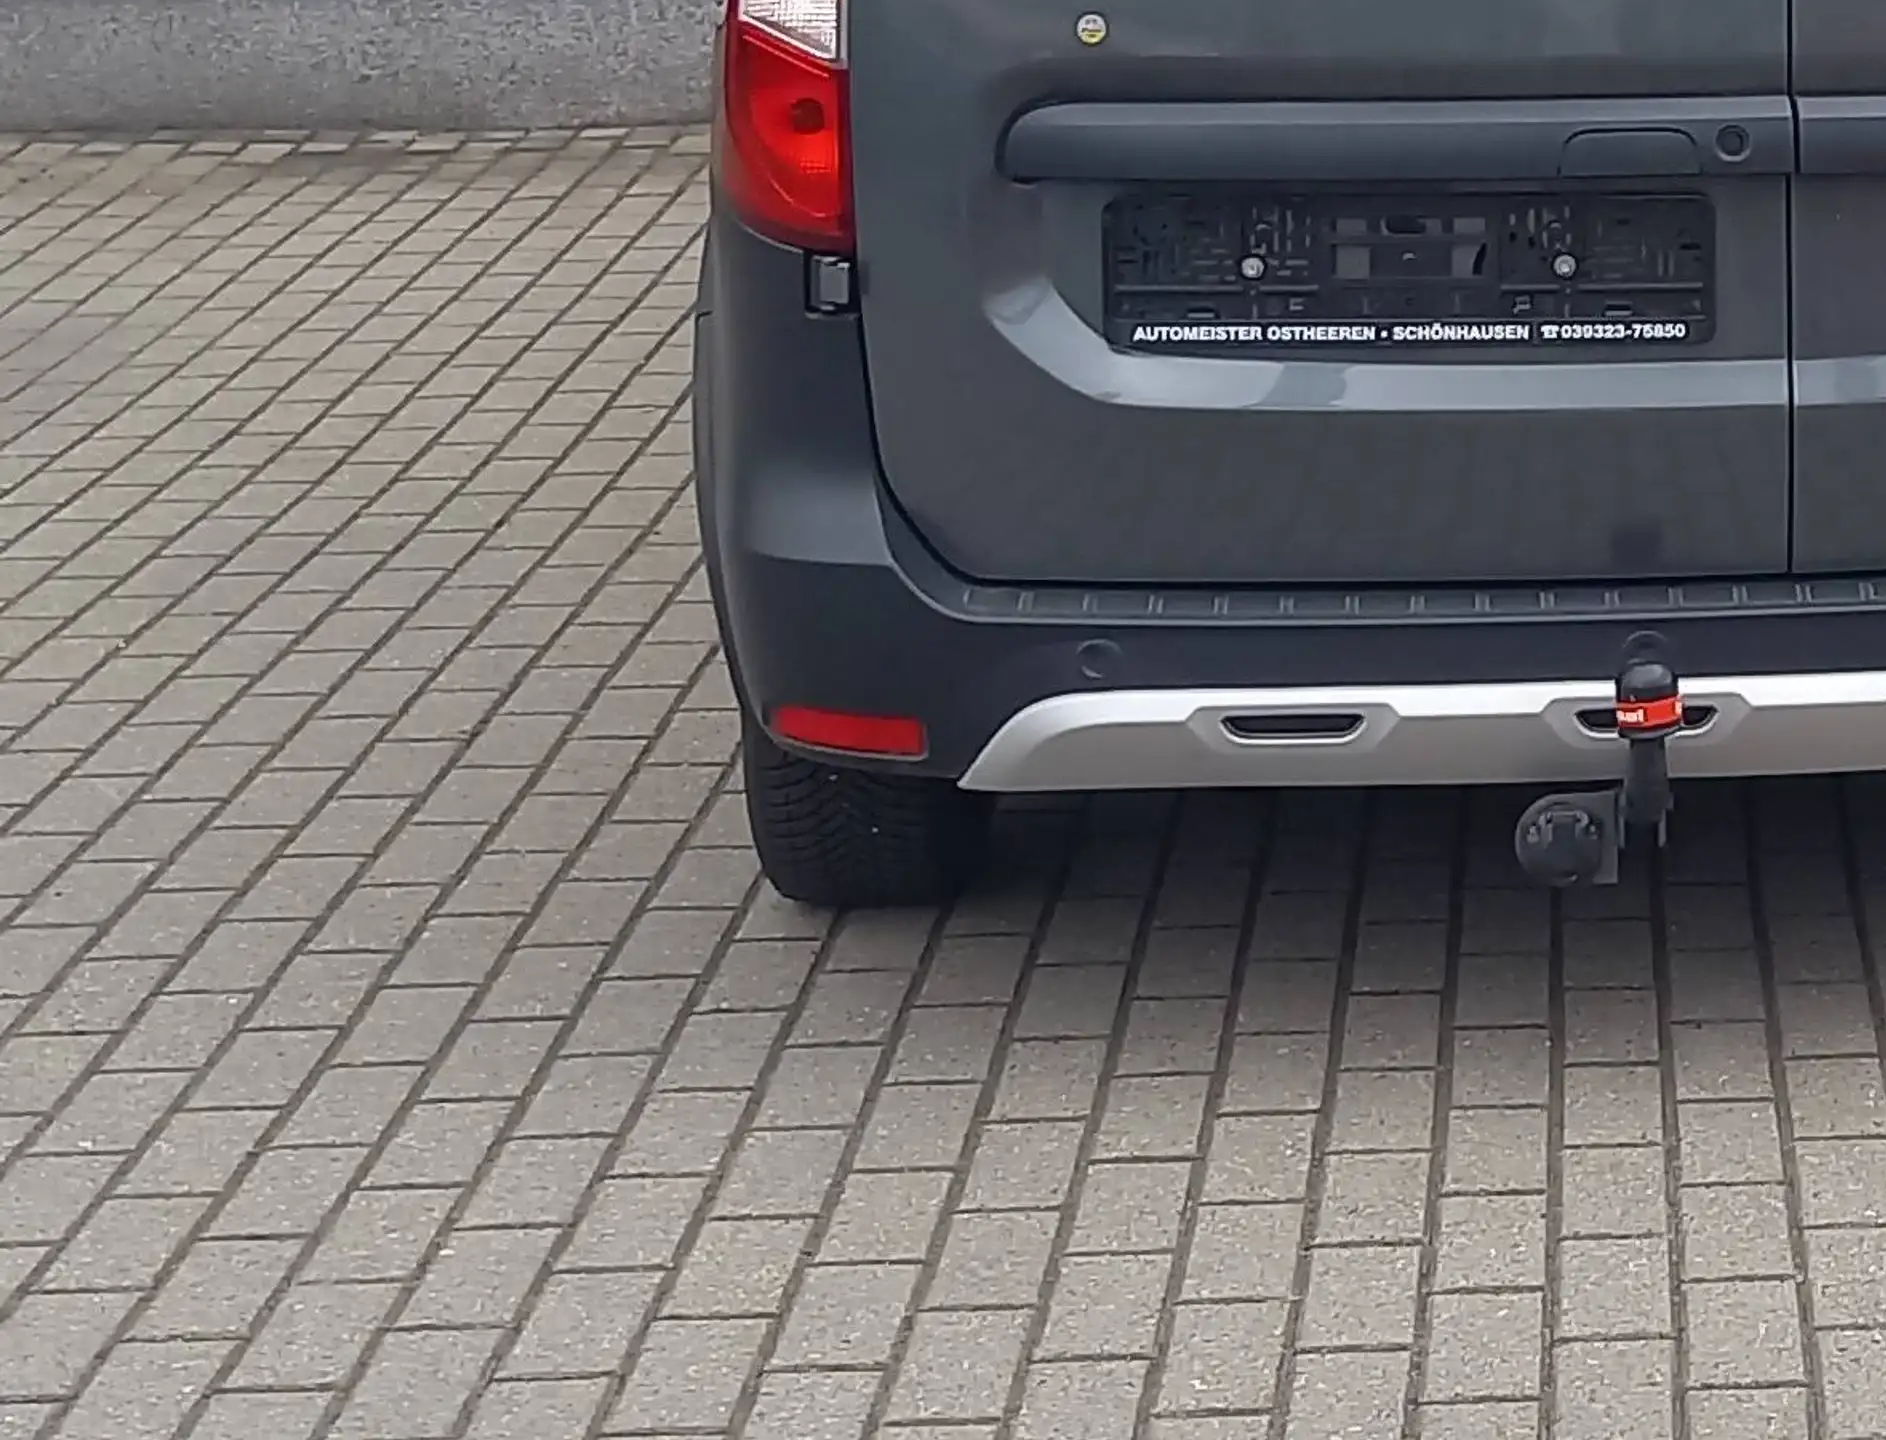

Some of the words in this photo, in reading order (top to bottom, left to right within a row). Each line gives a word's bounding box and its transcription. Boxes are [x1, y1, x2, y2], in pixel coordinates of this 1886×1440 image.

[1133, 325, 1263, 341] AUTOMEISTER
[1266, 325, 1376, 341] OSTHEEREN
[1392, 321, 1530, 340] SCHÖNHAUSEN
